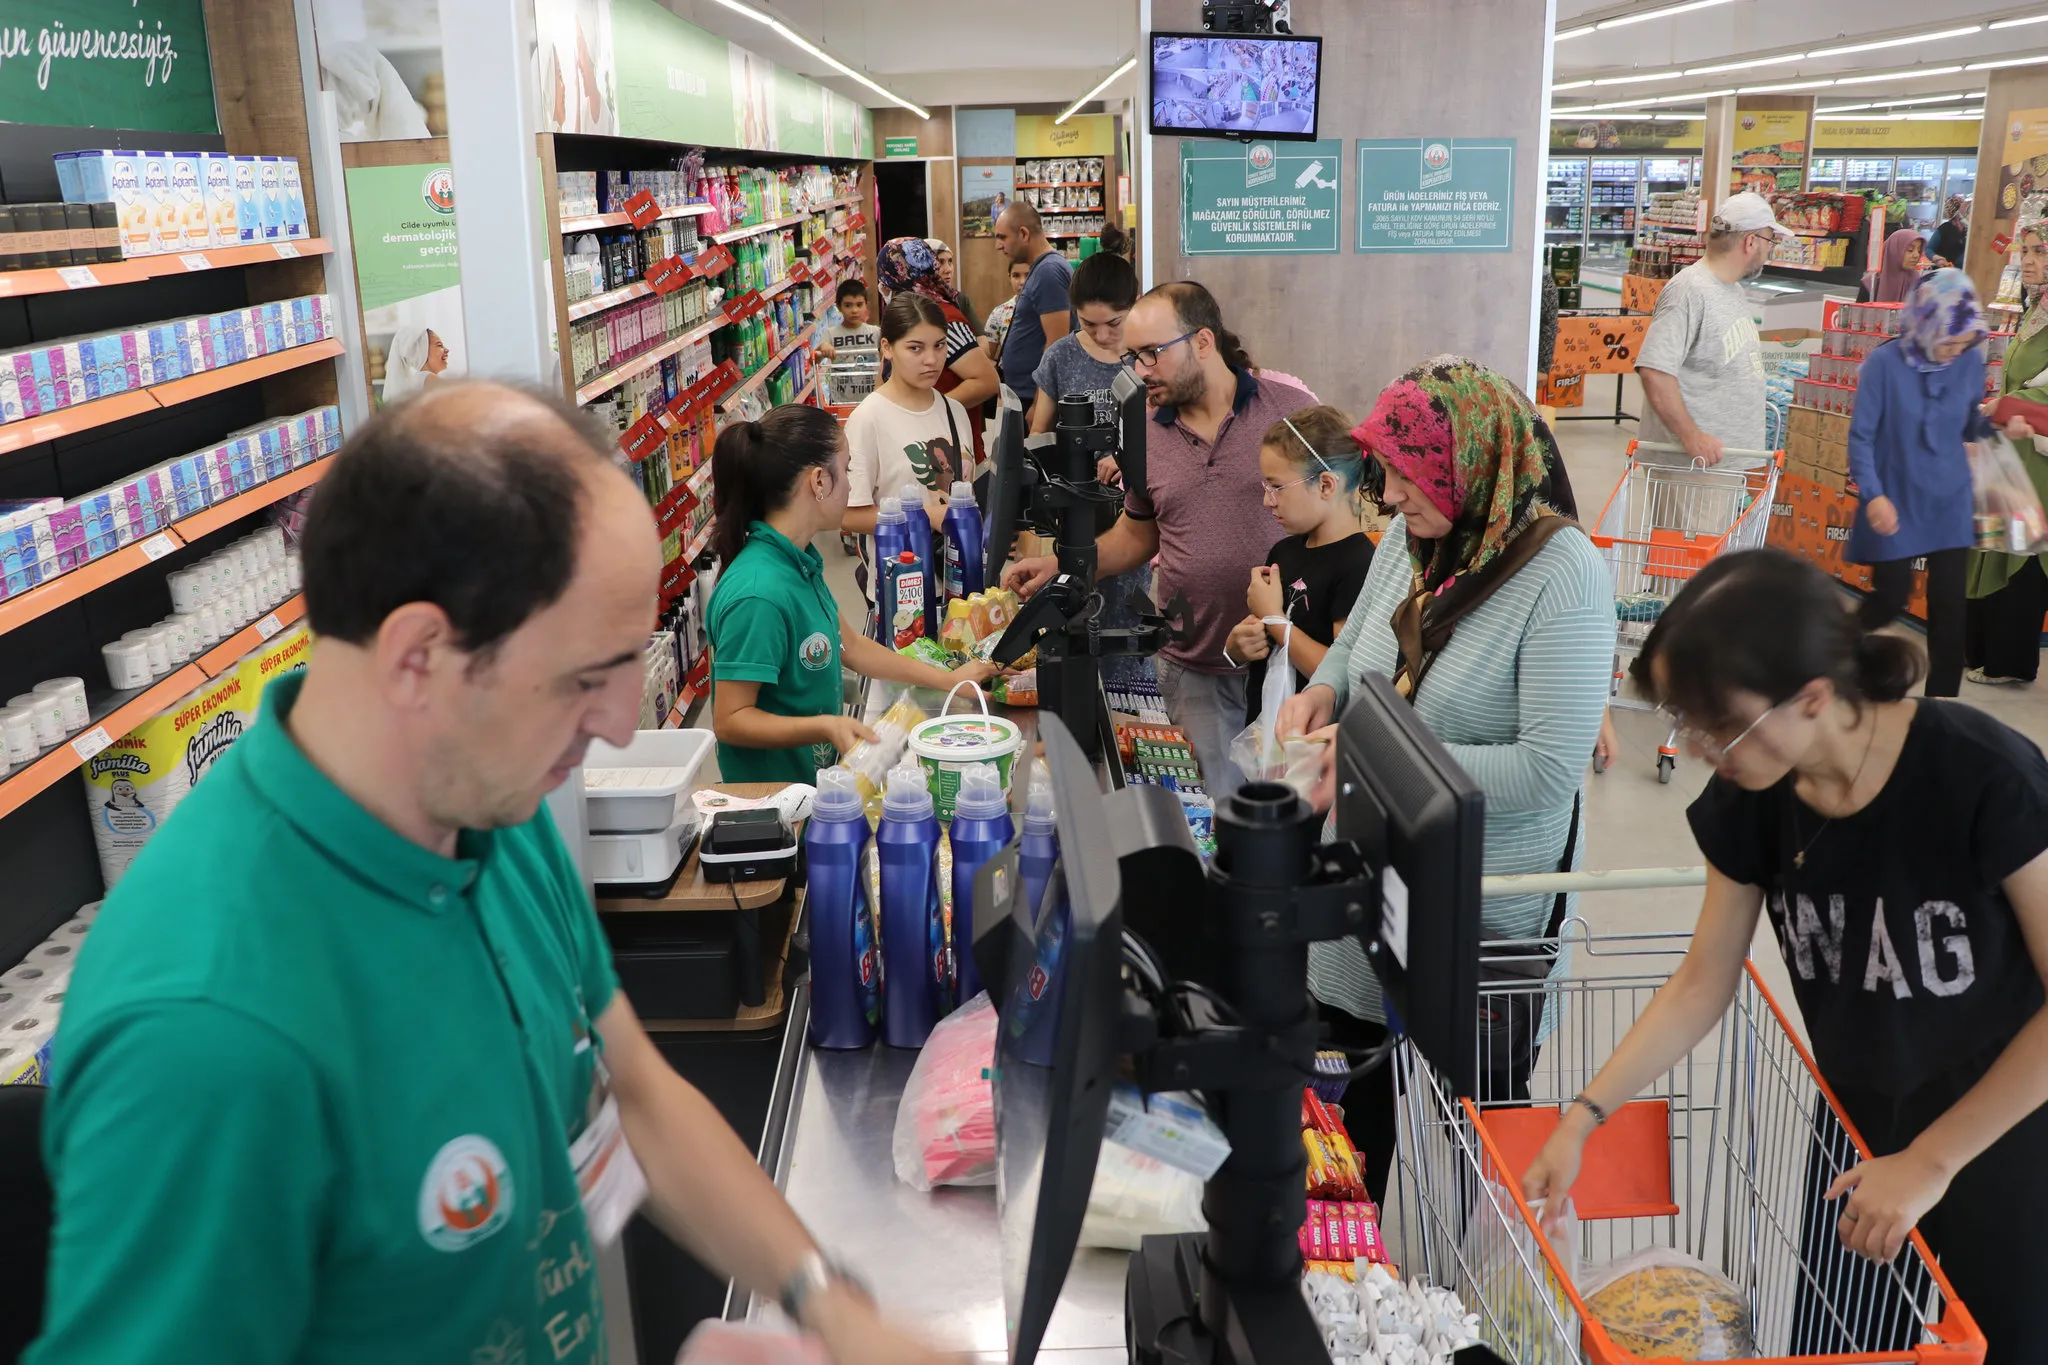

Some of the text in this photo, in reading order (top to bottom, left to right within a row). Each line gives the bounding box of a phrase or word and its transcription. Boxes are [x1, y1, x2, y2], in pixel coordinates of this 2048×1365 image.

[37, 19, 178, 90] güvencesiyiz.
[1216, 195, 1306, 208] SAYIN MÜŞTERİLERİMİZ
[1383, 190, 1488, 202] ÜRÜN İADELERİNİZ FİŞ VEYA
[633, 200, 653, 219] FIRSAT
[1368, 203, 1397, 212] FATURA
[1399, 203, 1409, 211] ile
[1410, 202, 1451, 211] YAPMANIZI
[1473, 201, 1502, 211] EDERİZ.
[1192, 209, 1240, 221] MAĞAZAMIZ
[1286, 208, 1330, 219] GÖRÜLMEZ
[401, 221, 421, 230] Cilde
[422, 219, 450, 230] uyumlu
[1211, 220, 1312, 232] GÜVENLİK SİSTEMLERİ ile
[382, 229, 457, 244] dermatolojik
[1225, 232, 1297, 243] KORUNMAKTADIR.
[704, 254, 720, 271] FIRSAT
[654, 268, 672, 287] FIRSAT
[833, 333, 875, 347] BACK
[1555, 374, 1582, 388] FIRSAT
[695, 385, 711, 401] FIRSAT
[676, 399, 693, 416] FIRSAT
[628, 433, 648, 453] FIRSAT
[663, 573, 679, 590] FIRSAT
[899, 586, 923, 601] %100
[259, 653, 283, 675] SÜPER
[174, 677, 243, 732] SÜPER EKONOMİK
[187, 710, 243, 787] familia
[91, 753, 151, 780] familia
[111, 770, 131, 778] PLUS
